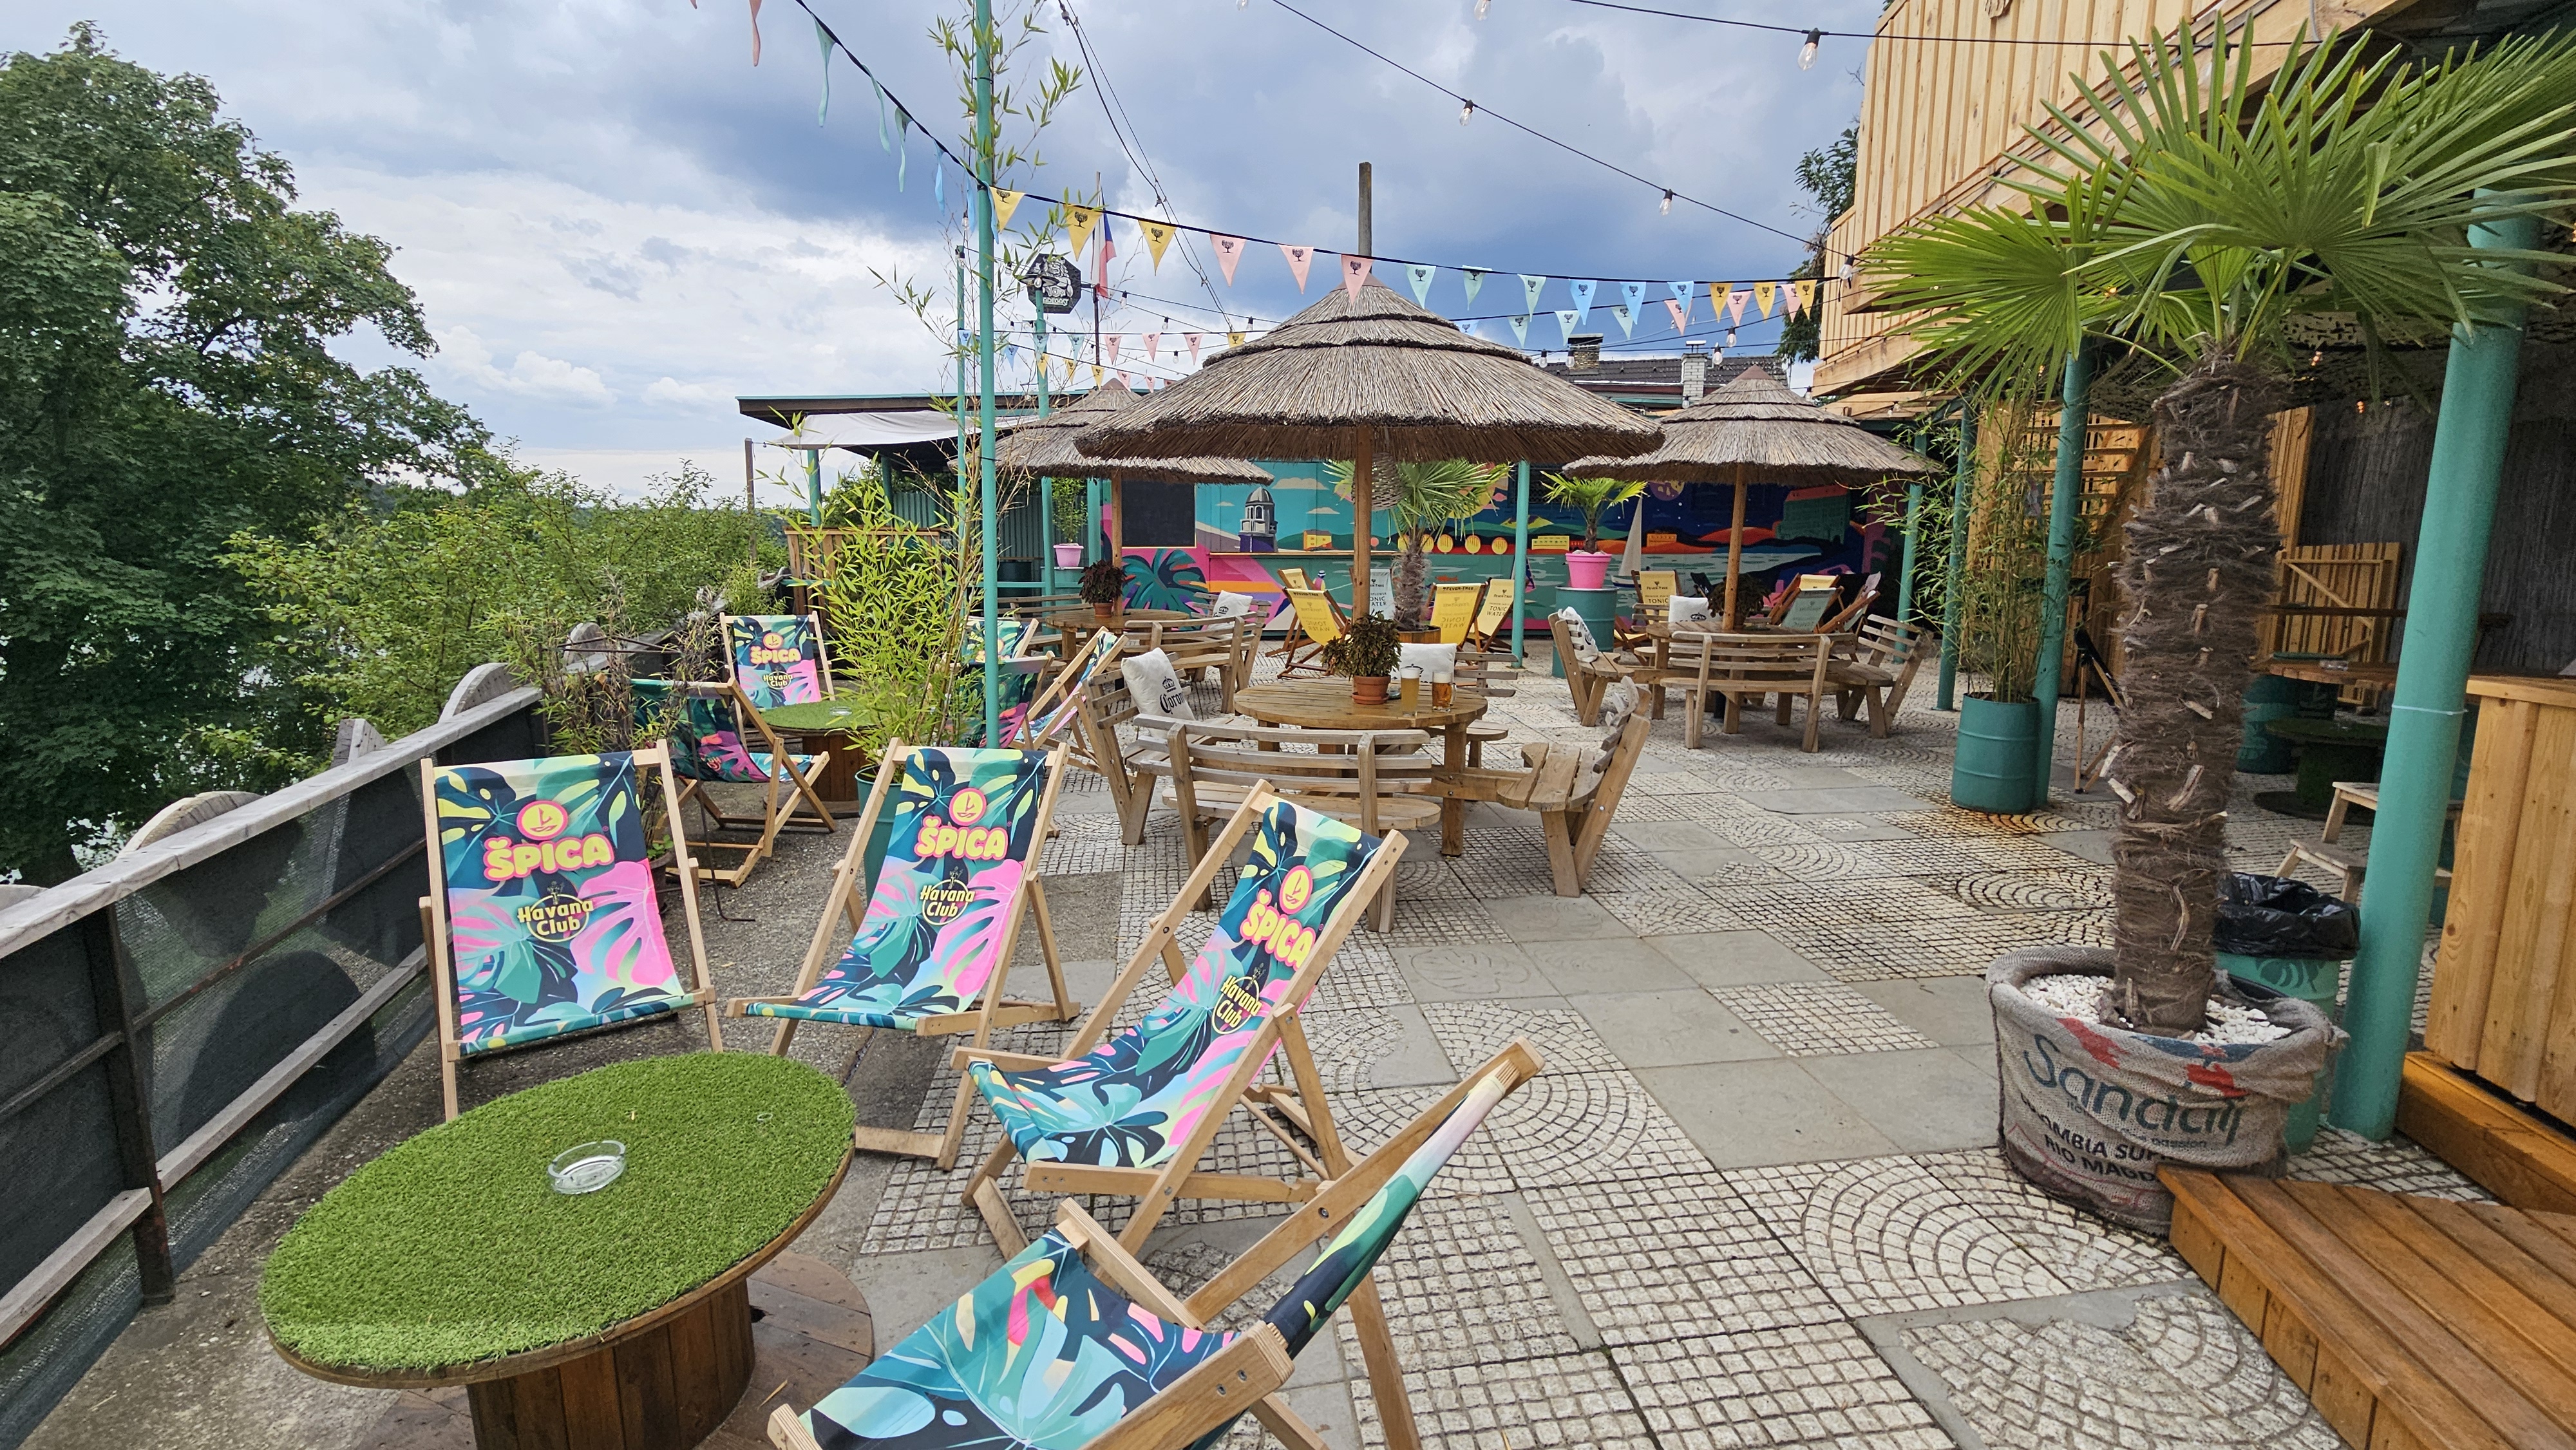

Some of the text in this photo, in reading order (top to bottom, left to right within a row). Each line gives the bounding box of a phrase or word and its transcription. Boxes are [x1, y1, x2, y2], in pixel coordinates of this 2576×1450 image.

[750, 646, 802, 664] ŠPICA
[914, 816, 1009, 860] ŠPICA
[484, 834, 614, 881] ŠPICA
[920, 885, 975, 902] Havana
[517, 900, 594, 923] Havana
[927, 901, 958, 917] Club
[536, 916, 581, 936] Club
[1240, 889, 1316, 971] ŠPICA
[1220, 975, 1262, 1016] Havana
[1217, 999, 1243, 1028] Club
